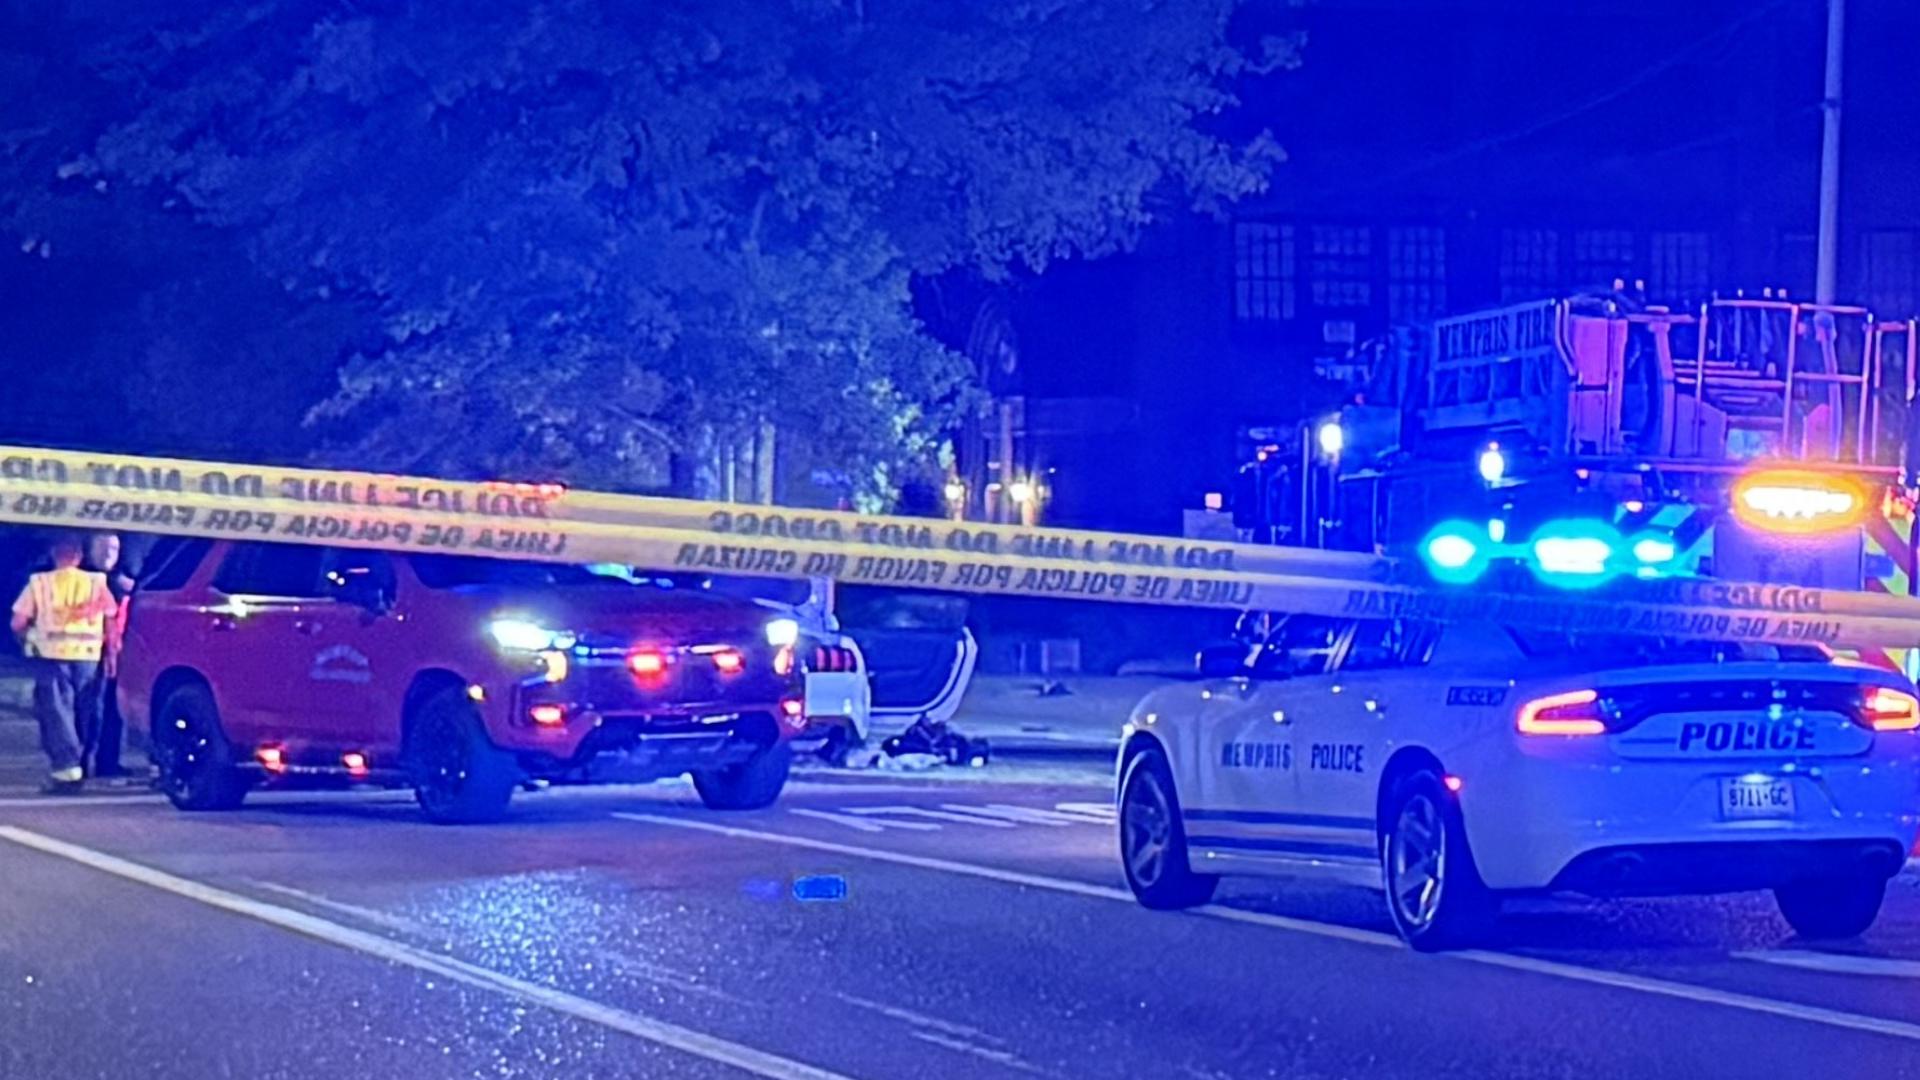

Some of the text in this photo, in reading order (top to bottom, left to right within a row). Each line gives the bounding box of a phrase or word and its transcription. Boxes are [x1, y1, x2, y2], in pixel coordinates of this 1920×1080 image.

[1438, 305, 1553, 362] MEMPHIS FIRE
[1679, 721, 1817, 751] POLICE
[1221, 743, 1364, 773] MEMPHIS POLICE
